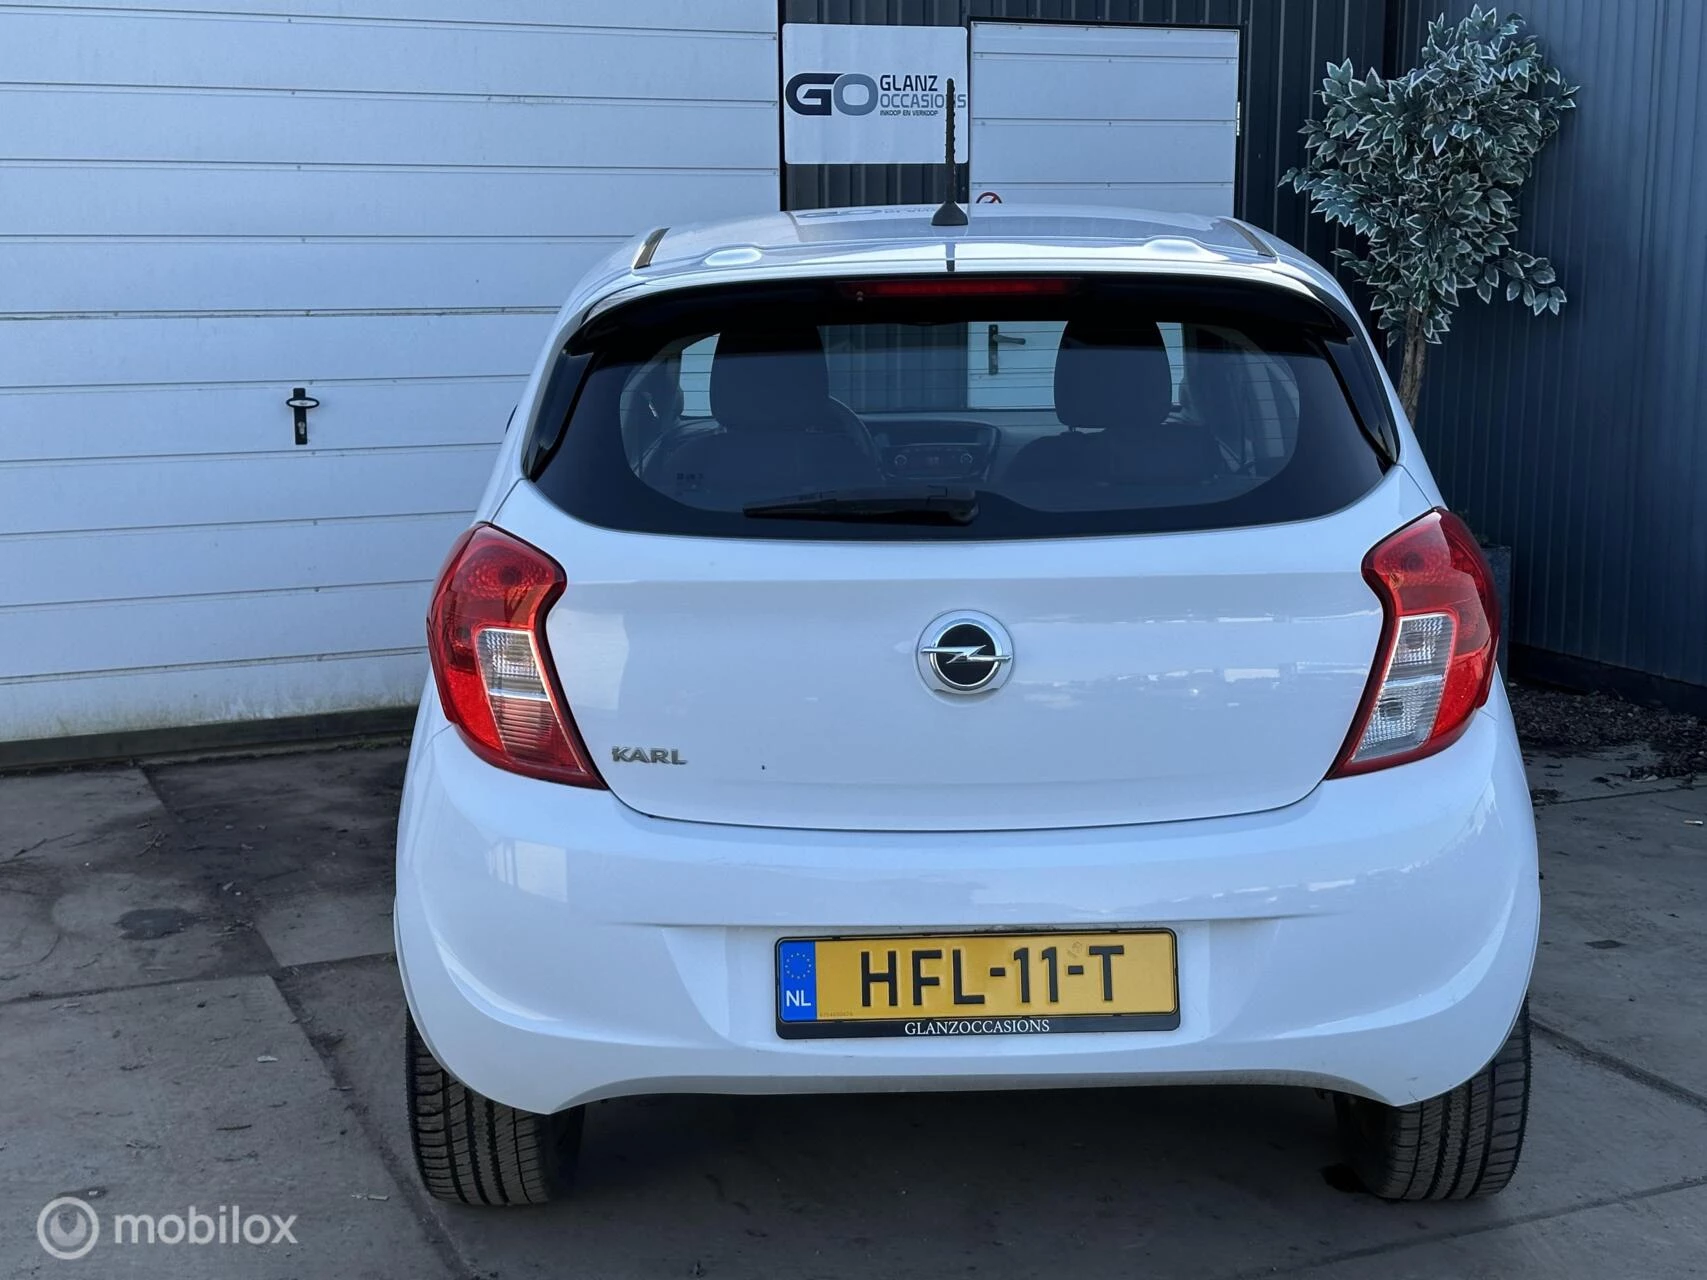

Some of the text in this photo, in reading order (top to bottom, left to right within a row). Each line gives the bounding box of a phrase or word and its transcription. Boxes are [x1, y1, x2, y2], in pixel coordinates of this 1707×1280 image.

[880, 74, 938, 92] GLANZ
[785, 72, 879, 116] GO
[880, 93, 967, 108] OCCASIOS
[611, 745, 689, 765] KARL
[786, 944, 1125, 1007] NL HFL-11-T
[904, 1019, 1050, 1036] GLANZOCCASIONS
